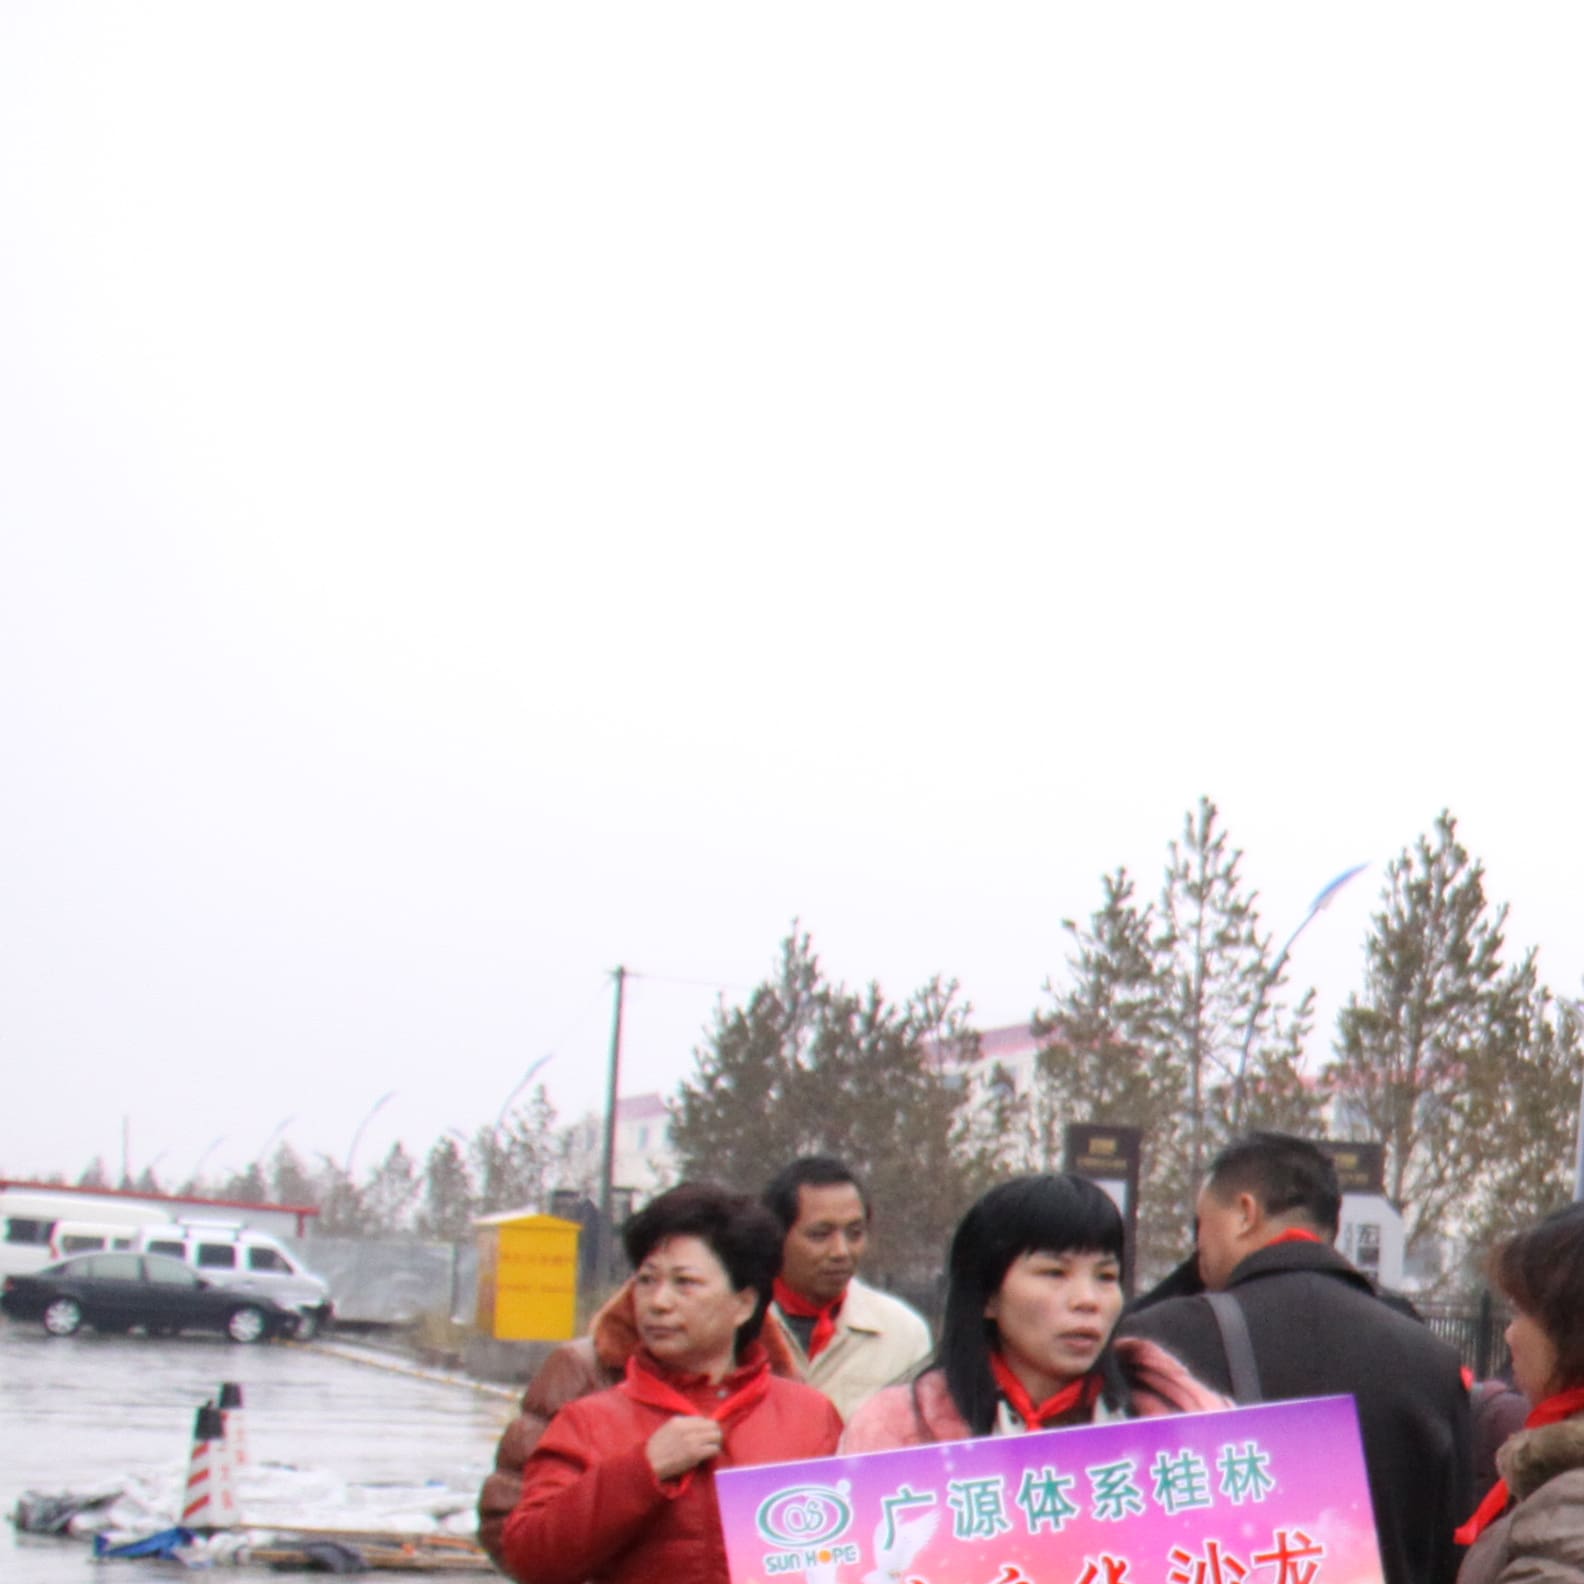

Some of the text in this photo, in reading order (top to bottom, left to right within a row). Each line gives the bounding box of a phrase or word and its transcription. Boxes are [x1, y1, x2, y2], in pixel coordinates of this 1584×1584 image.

[880, 1442, 1275, 1551] 广源体系桂林
[764, 1544, 858, 1574] SUN HOPE
